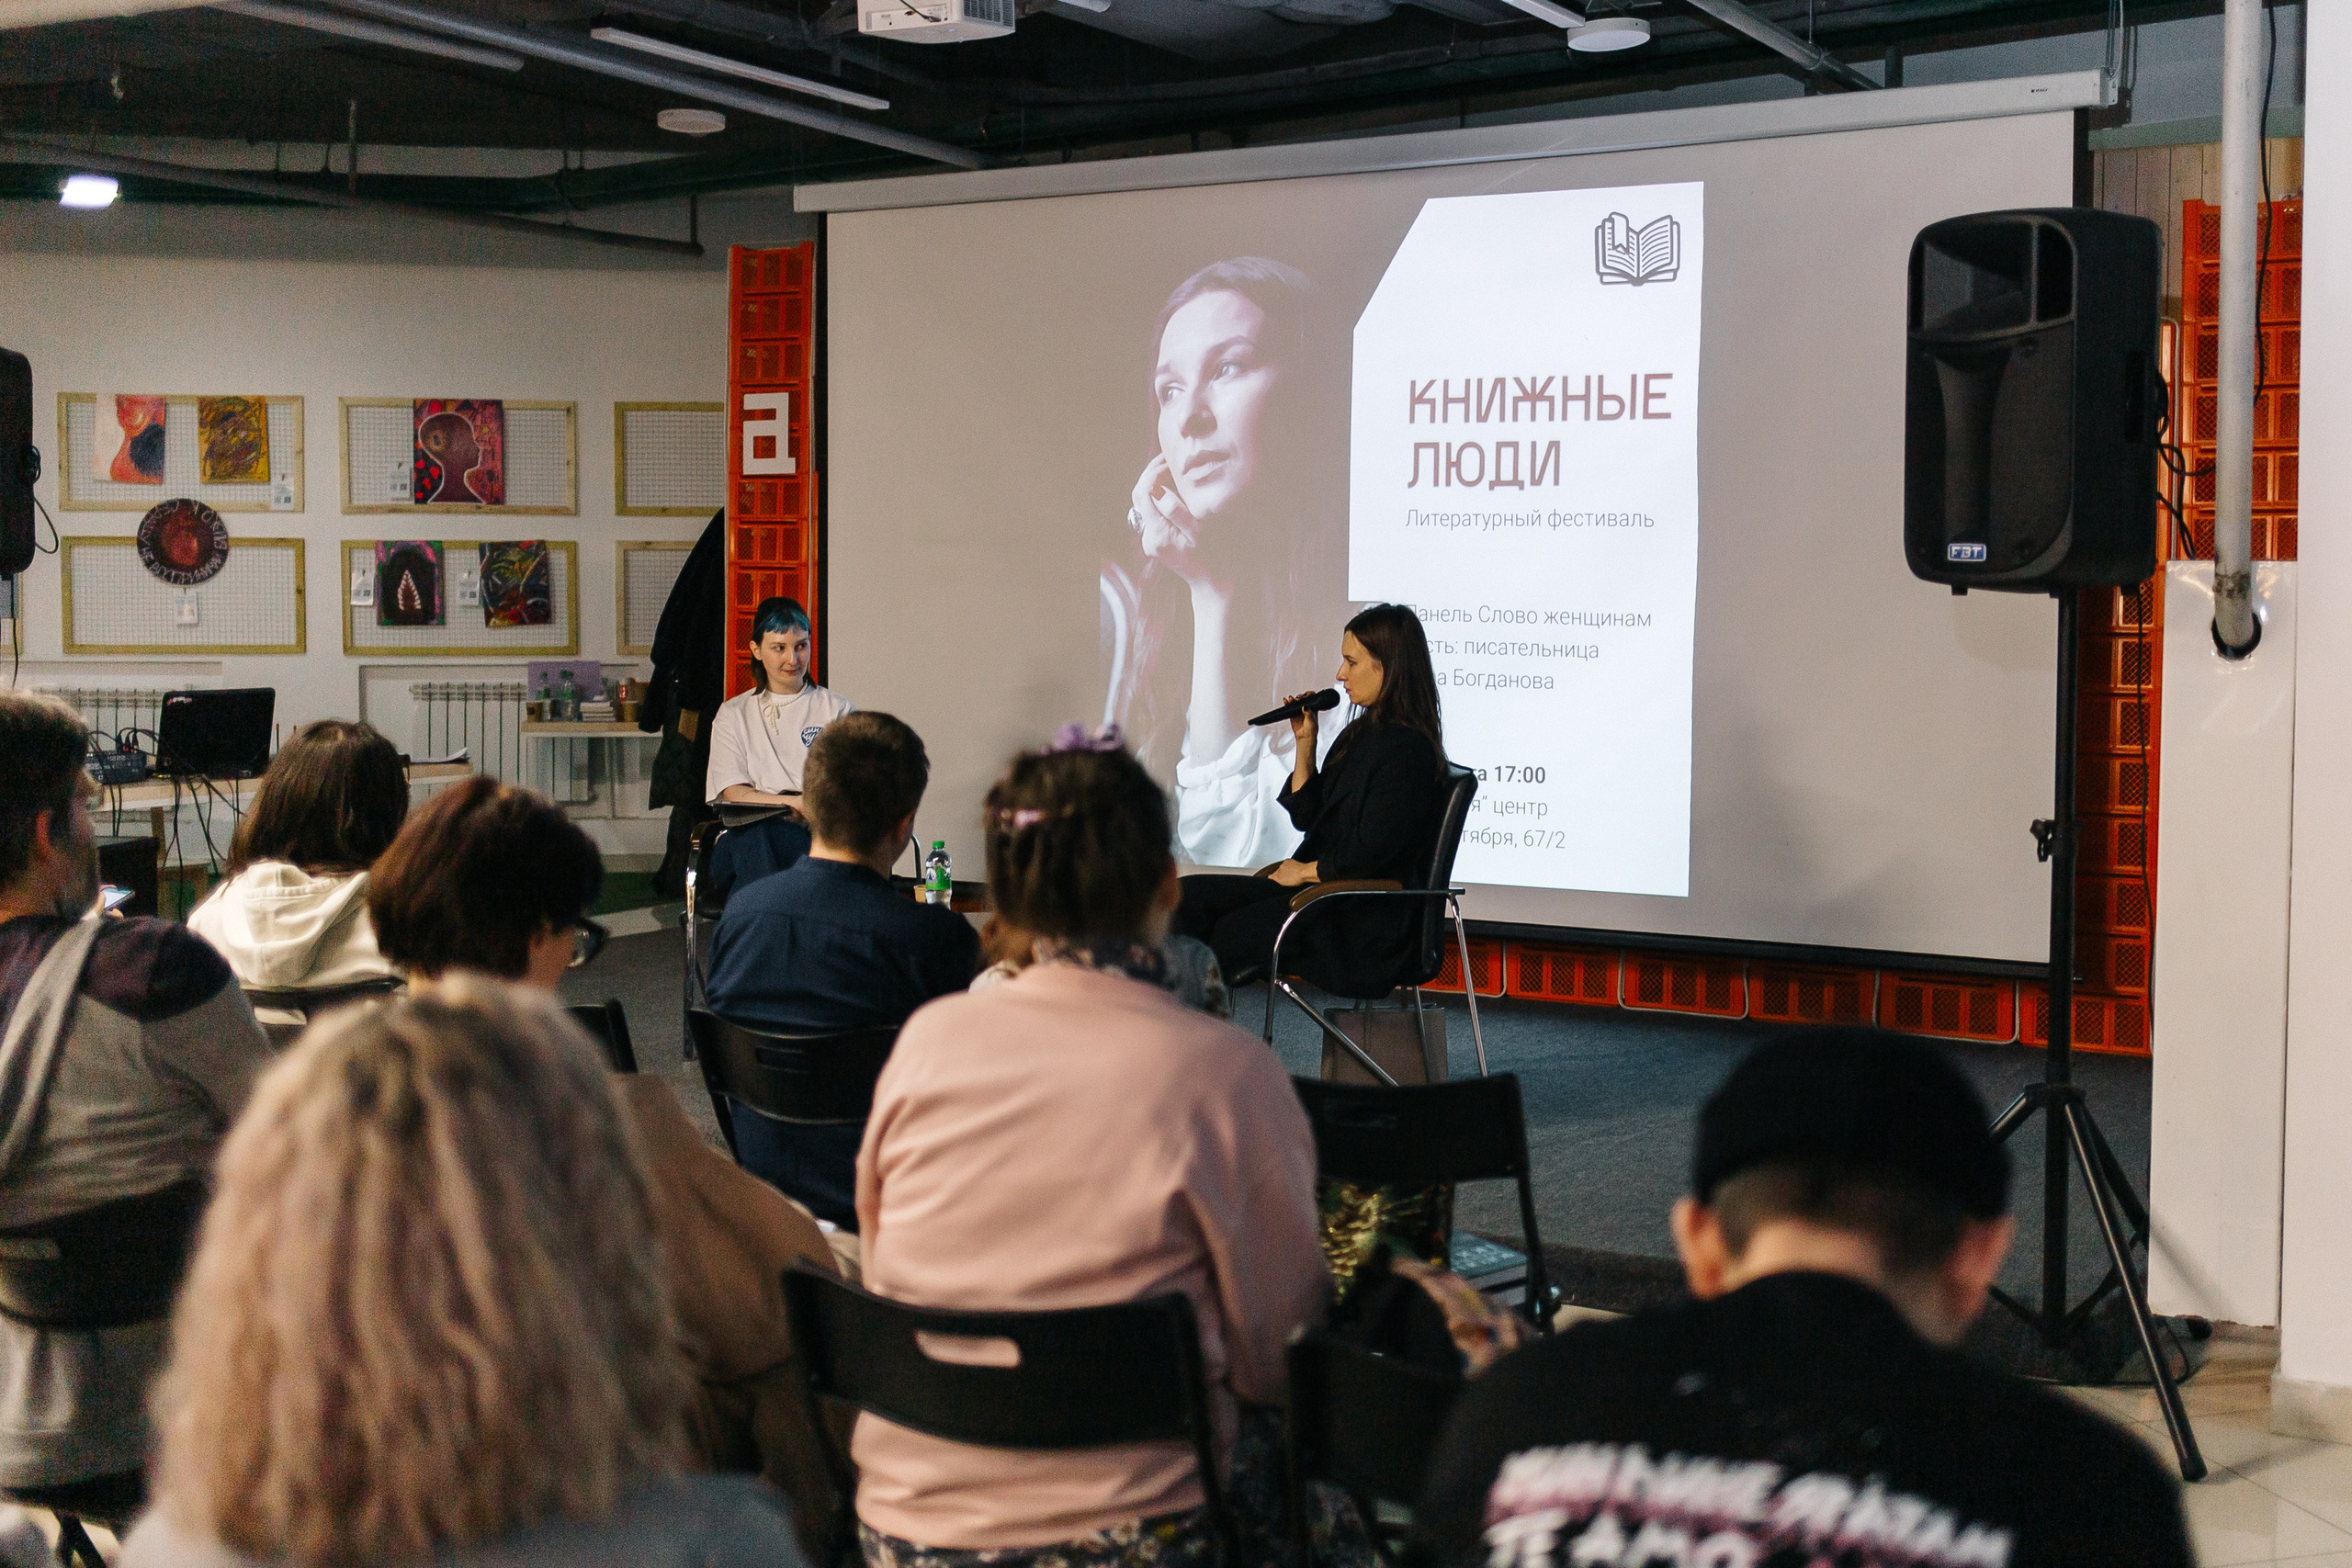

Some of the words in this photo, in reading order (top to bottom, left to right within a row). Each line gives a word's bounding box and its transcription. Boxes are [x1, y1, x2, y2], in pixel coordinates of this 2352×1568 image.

[1408, 372, 1674, 424] КНИЖНЫЕ
[1407, 440, 1561, 491] ЛЮДИ
[1405, 509, 1542, 532] Литературный
[1547, 508, 1655, 532] фестиваль
[1951, 546, 1983, 558] FBT
[1478, 604, 1538, 625] Слово
[1544, 611, 1652, 630] женщинам
[1426, 639, 1458, 655] сть:
[1464, 640, 1600, 662] писательница
[1453, 668, 1555, 692] Богданова
[1494, 765, 1546, 784] 17:00
[1493, 800, 1548, 820] центр
[1462, 826, 1518, 850] тября,
[1523, 829, 1566, 850] 67/2
